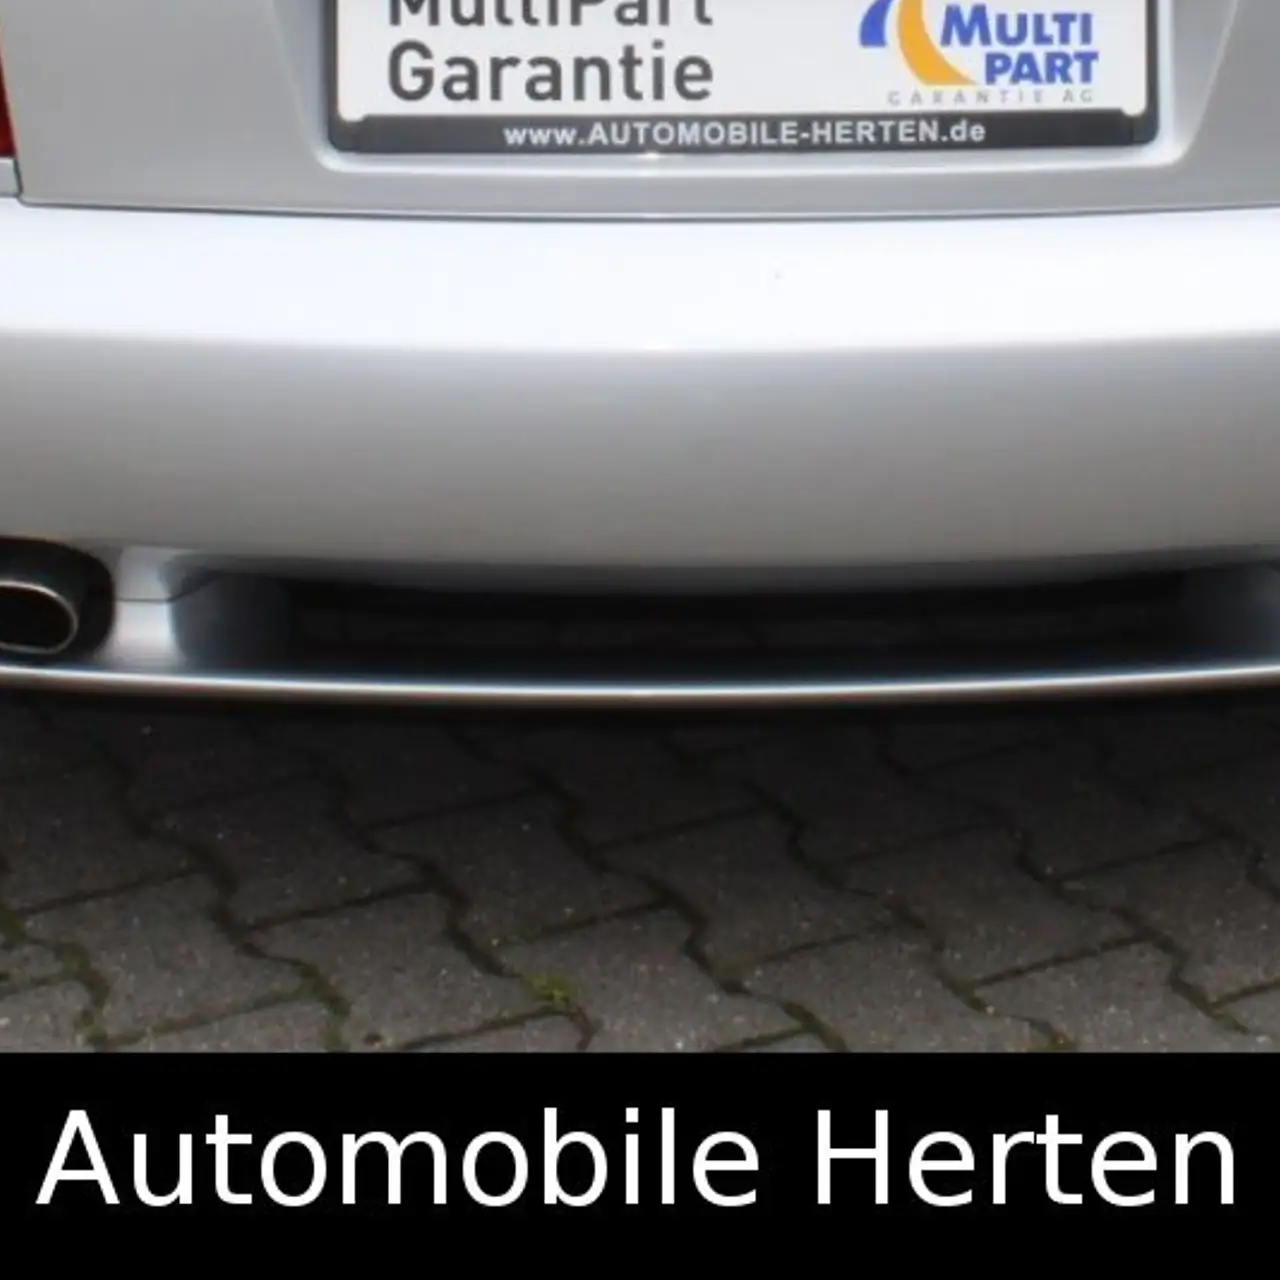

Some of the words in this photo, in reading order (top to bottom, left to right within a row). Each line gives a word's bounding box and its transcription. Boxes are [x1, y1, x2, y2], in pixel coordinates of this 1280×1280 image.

[388, 39, 714, 102] Garantie
[984, 50, 1100, 85] PART
[887, 89, 1045, 106] GARANTIE
[1062, 87, 1094, 104] AG
[503, 120, 987, 148] www.AUTOMOBILE-HERTEN.de
